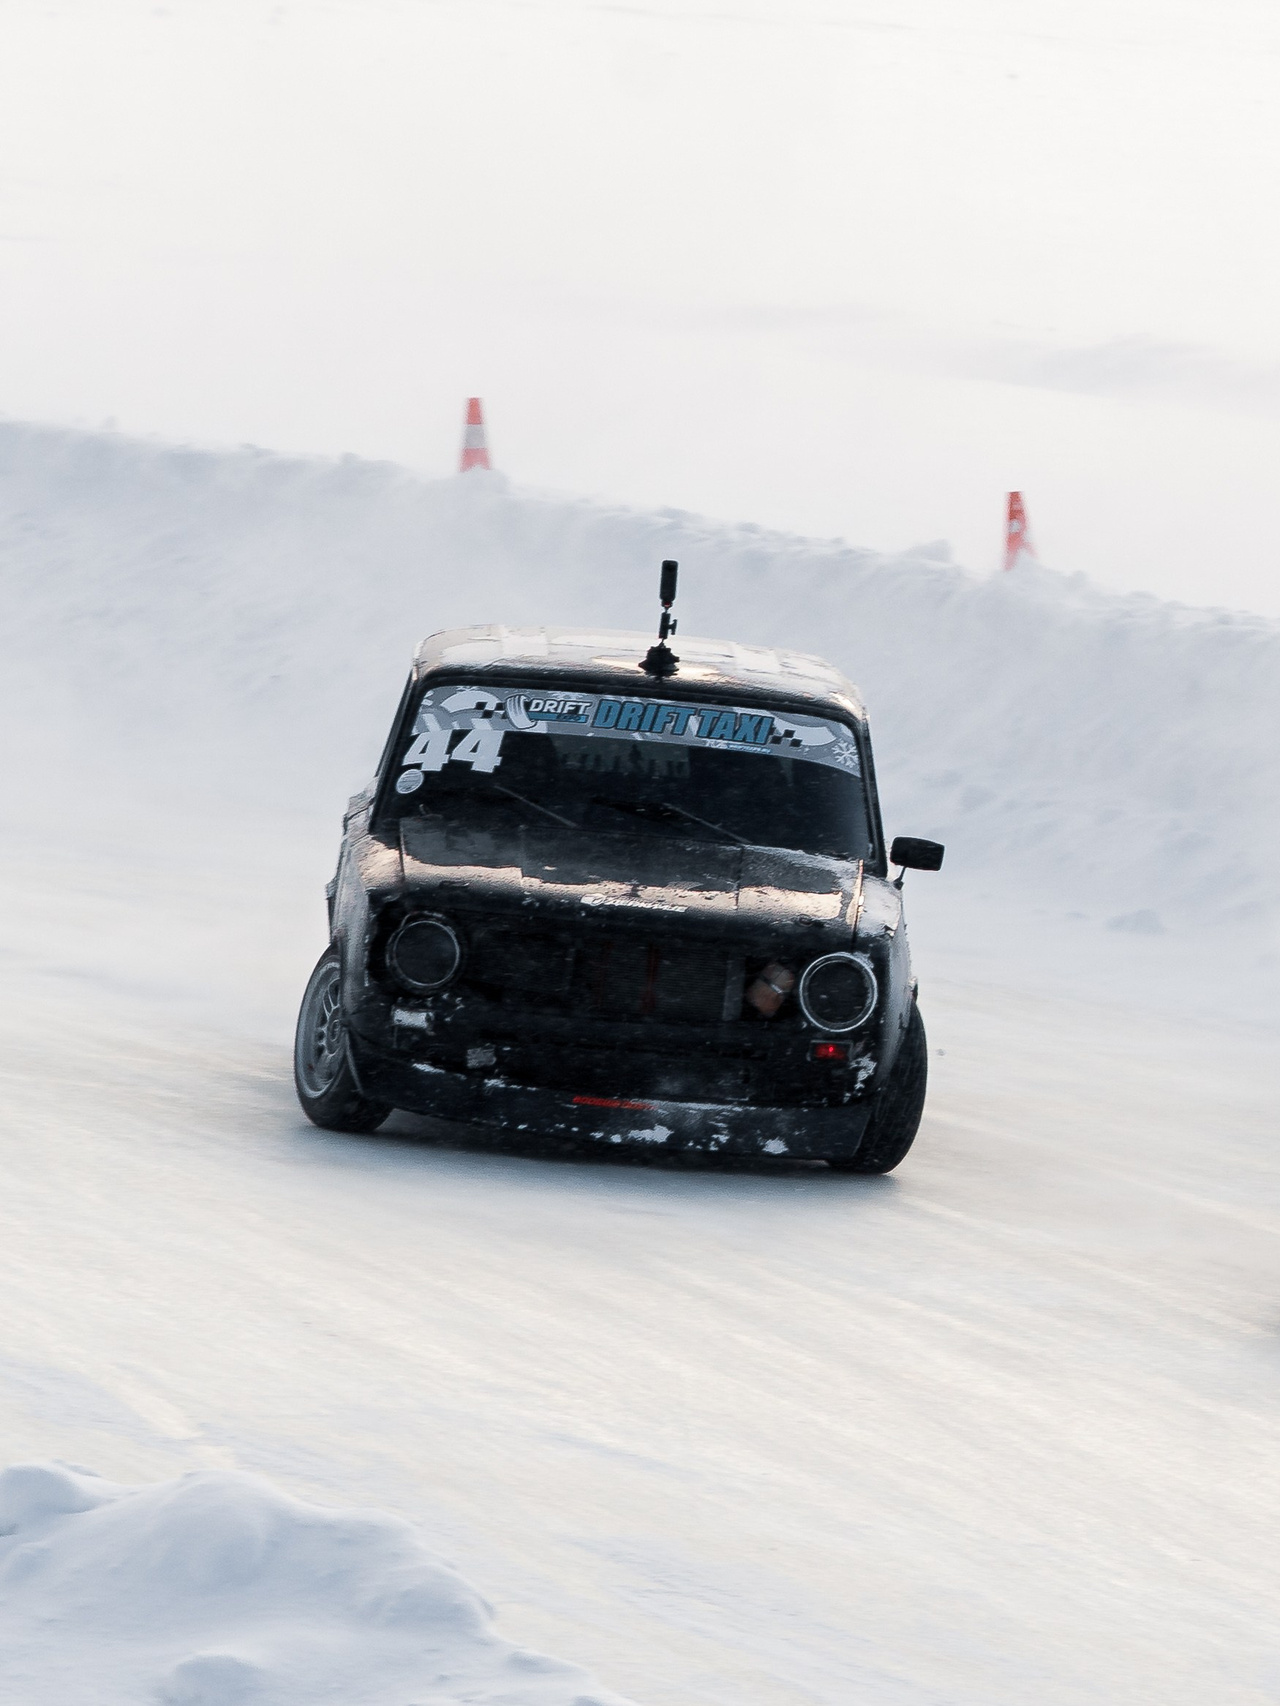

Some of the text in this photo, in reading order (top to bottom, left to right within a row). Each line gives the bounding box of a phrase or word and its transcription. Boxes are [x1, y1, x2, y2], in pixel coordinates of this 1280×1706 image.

[528, 698, 592, 716] DRIFT
[591, 698, 775, 745] DRIFT TAXI
[402, 729, 505, 773] 44
